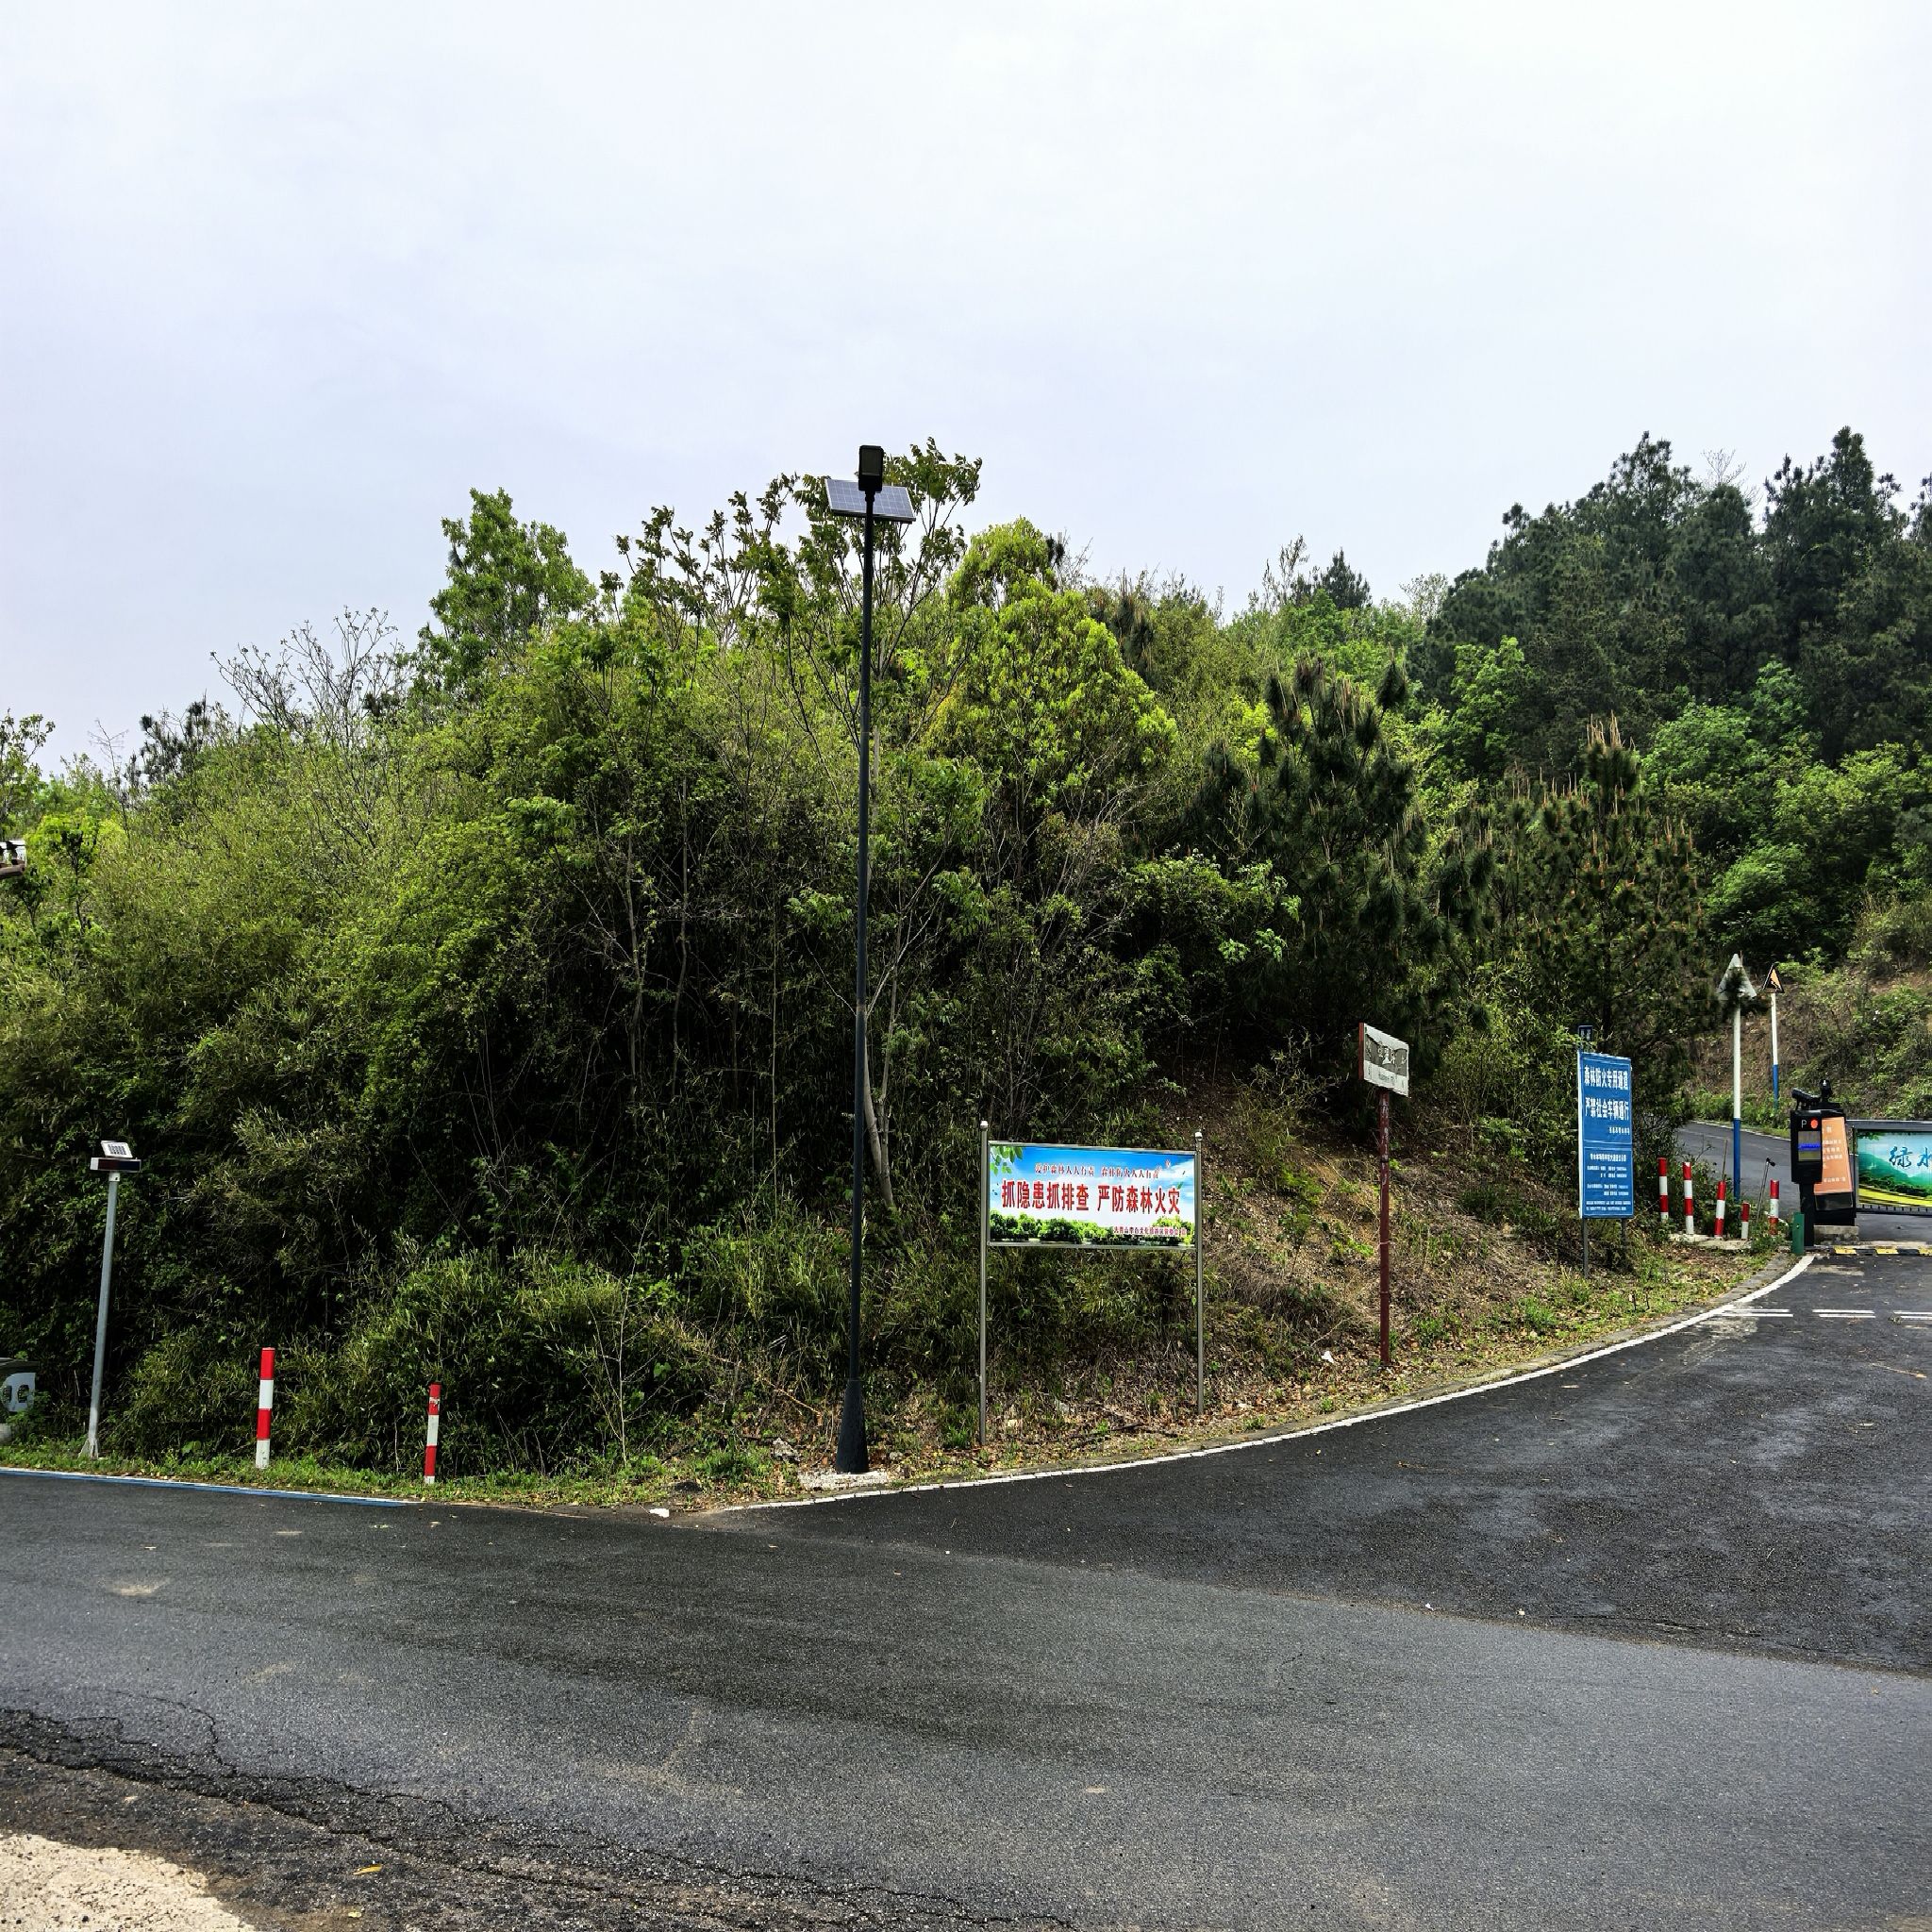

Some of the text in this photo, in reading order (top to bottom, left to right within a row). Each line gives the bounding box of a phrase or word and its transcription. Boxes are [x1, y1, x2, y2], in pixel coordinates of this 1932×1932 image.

[1801, 1119, 1807, 1128] P
[1002, 1179, 1181, 1214] 抓隐患抓排查 严防森林火灾
